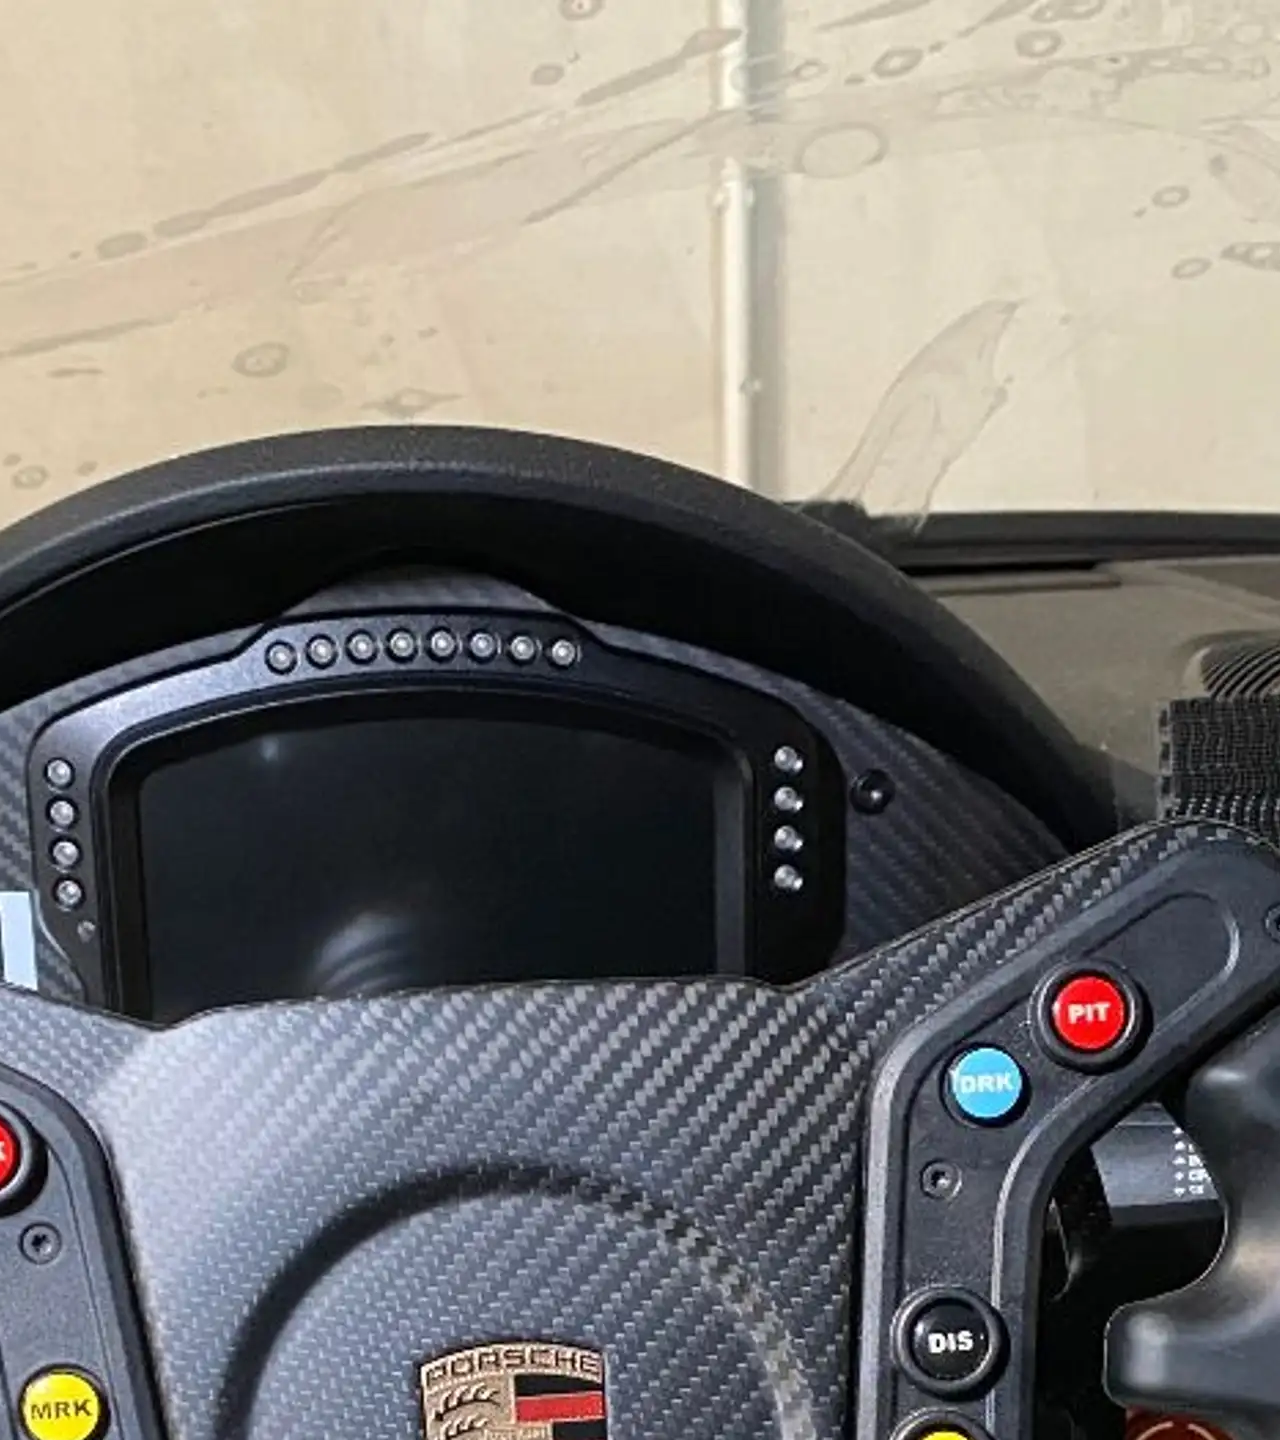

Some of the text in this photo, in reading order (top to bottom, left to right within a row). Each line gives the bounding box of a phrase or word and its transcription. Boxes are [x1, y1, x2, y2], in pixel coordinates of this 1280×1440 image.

[1067, 1002, 1111, 1025] PIT
[960, 1072, 1015, 1094] DRK
[927, 1330, 974, 1354] DIS
[424, 1350, 603, 1387] PORSCHE
[30, 1399, 94, 1421] MRK
